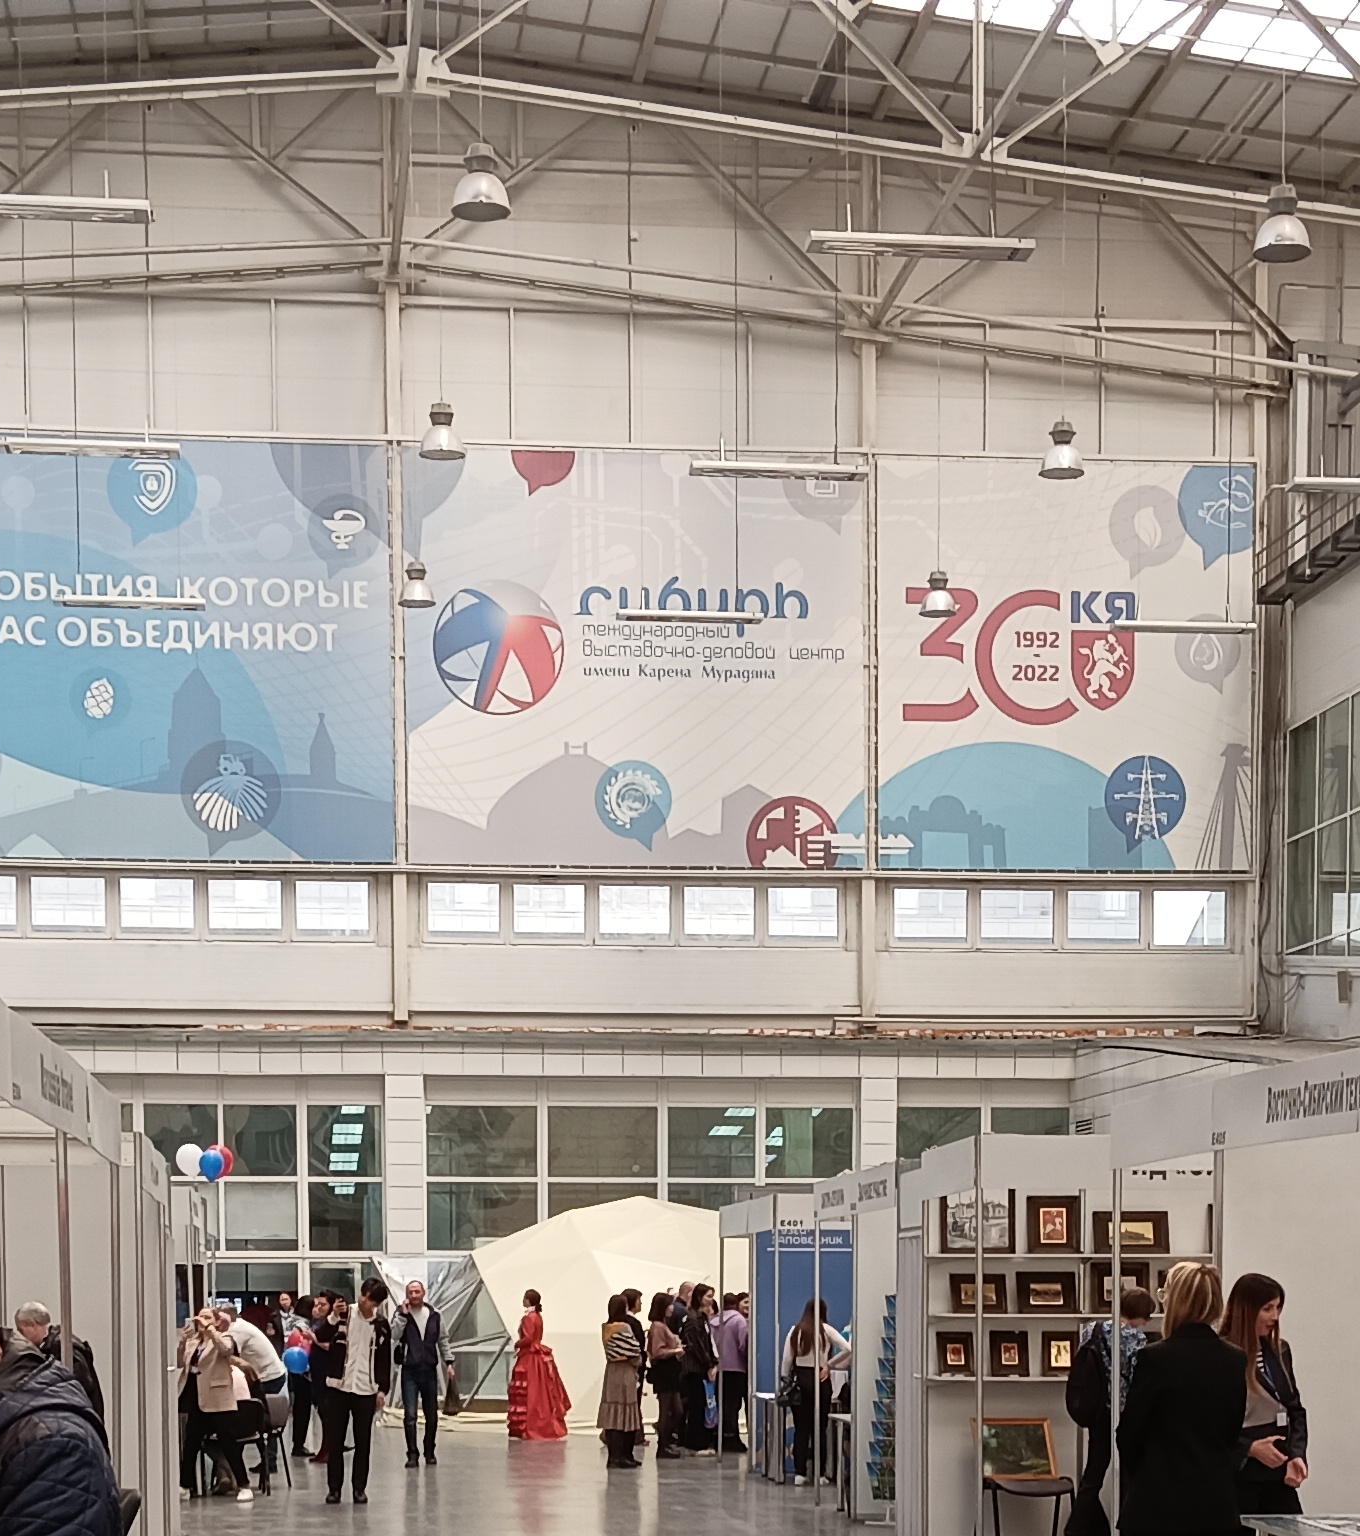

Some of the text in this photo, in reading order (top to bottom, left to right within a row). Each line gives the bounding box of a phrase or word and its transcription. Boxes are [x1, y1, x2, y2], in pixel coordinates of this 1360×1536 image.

[182, 577, 370, 610] КОТОРЫЕ
[1070, 590, 1137, 625] КЯ
[56, 616, 339, 655] ОБЪЕДИНЯЮТ
[1014, 630, 1060, 649] 1992
[789, 646, 846, 663] центр
[583, 663, 776, 683] имени Карена Мурадяна
[1011, 664, 1060, 682] 2022
